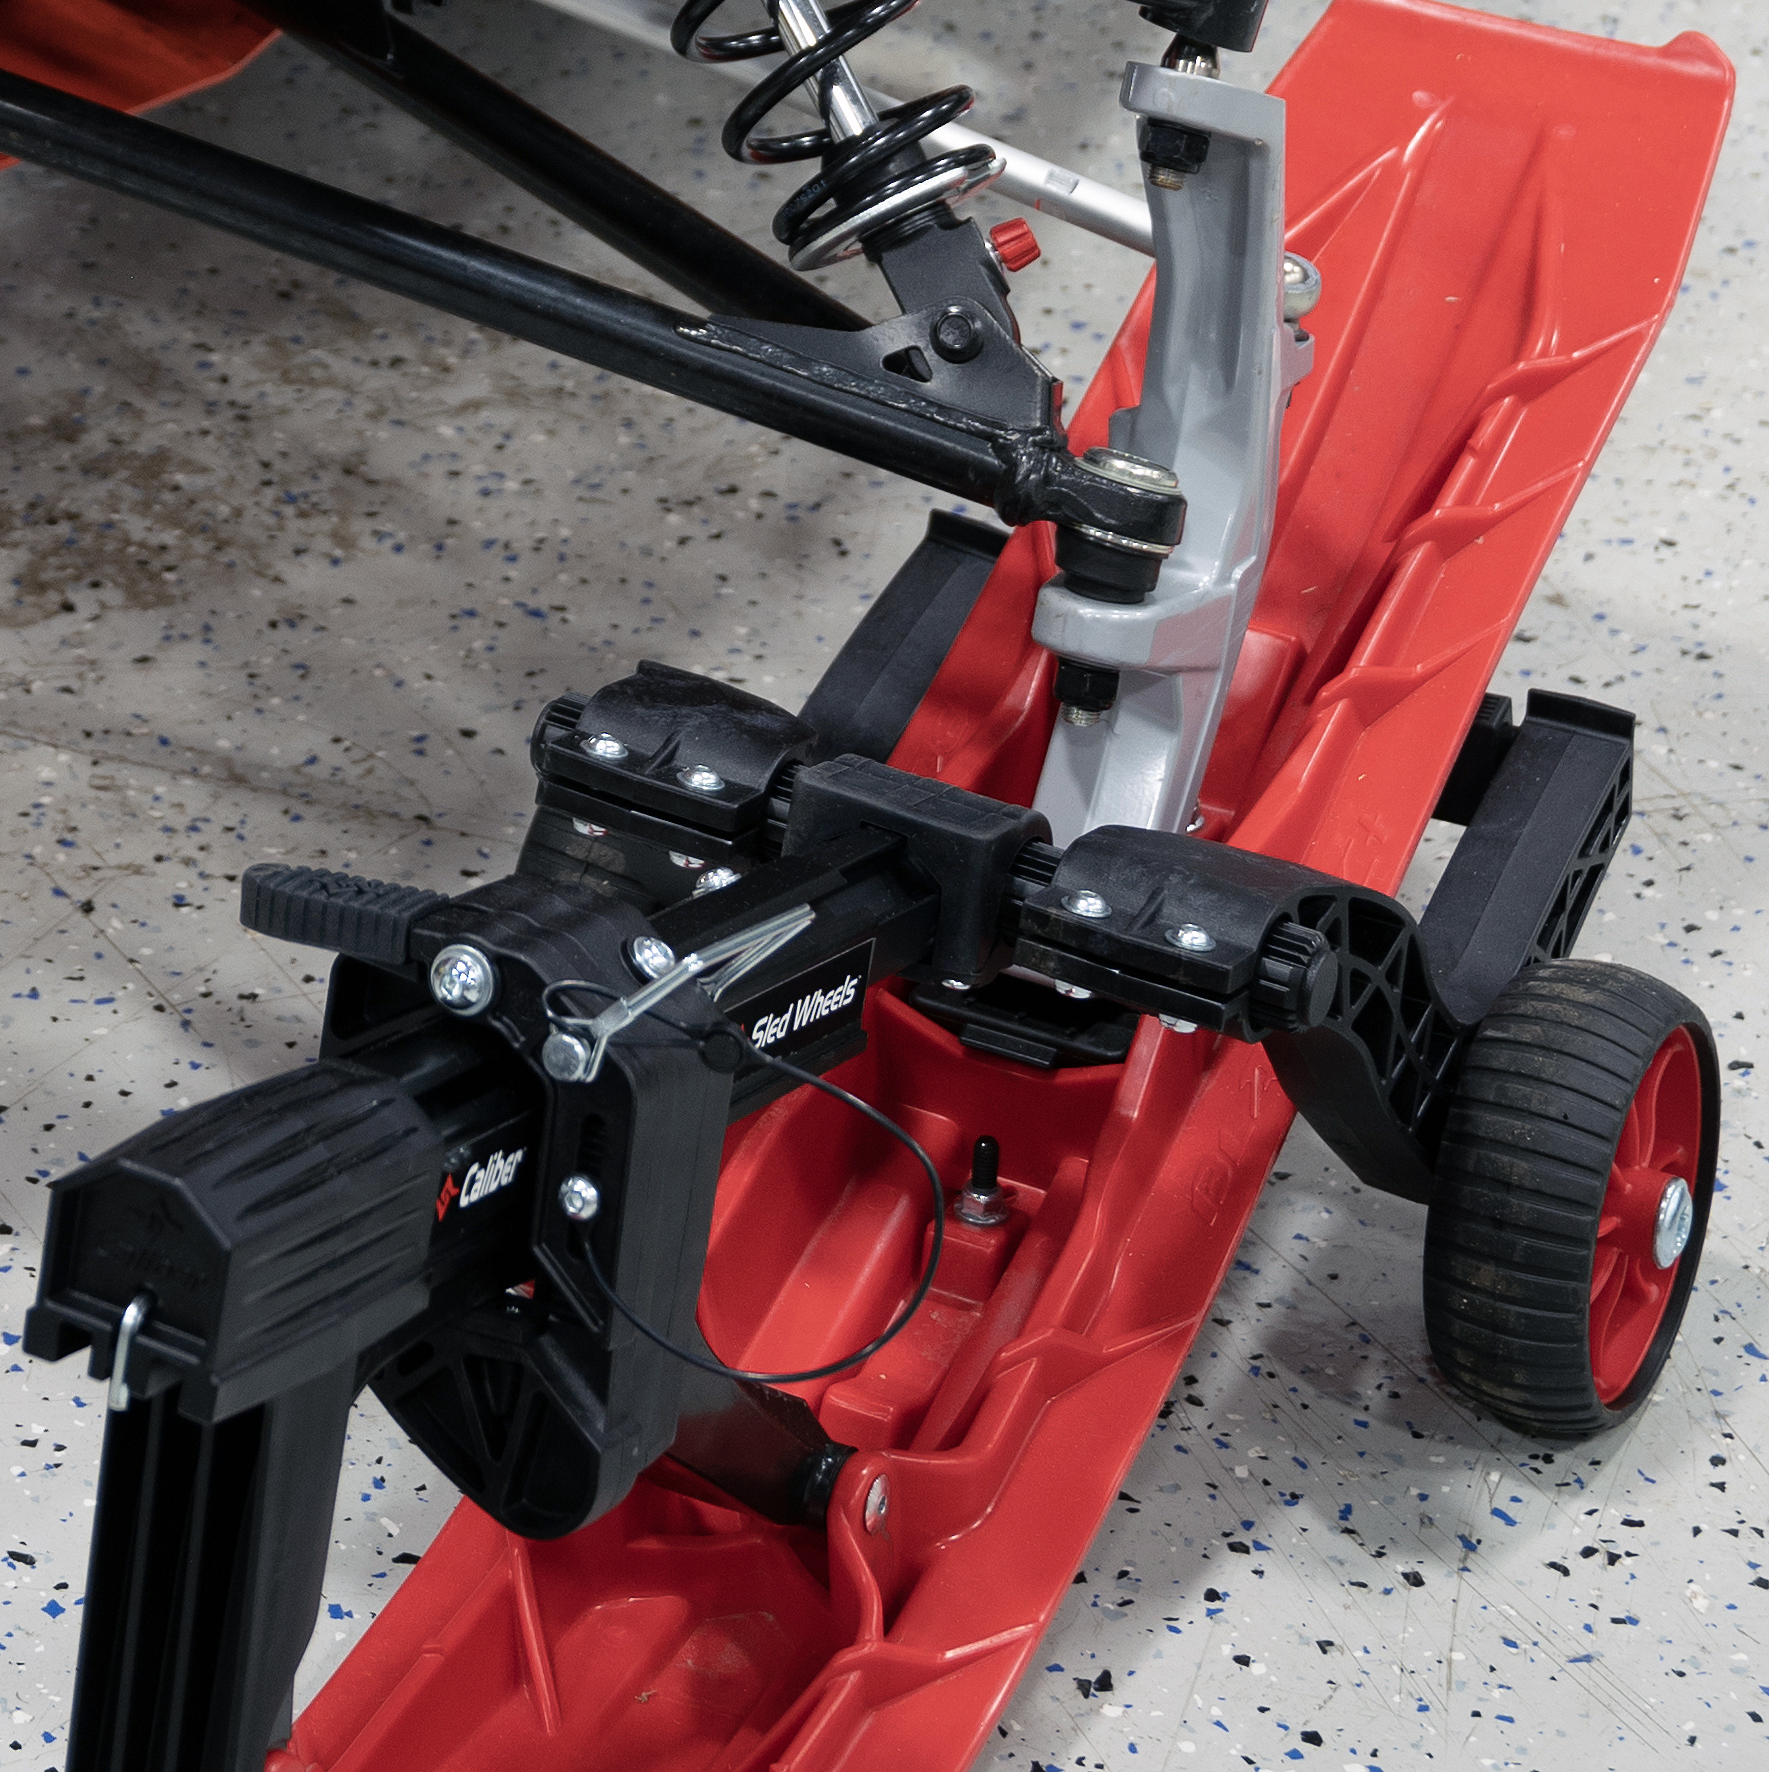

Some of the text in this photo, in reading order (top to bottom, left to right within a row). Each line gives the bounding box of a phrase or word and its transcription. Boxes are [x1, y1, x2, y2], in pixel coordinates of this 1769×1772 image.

[751, 974, 858, 1049] Sled Wheels
[459, 1149, 523, 1208] Caliber
